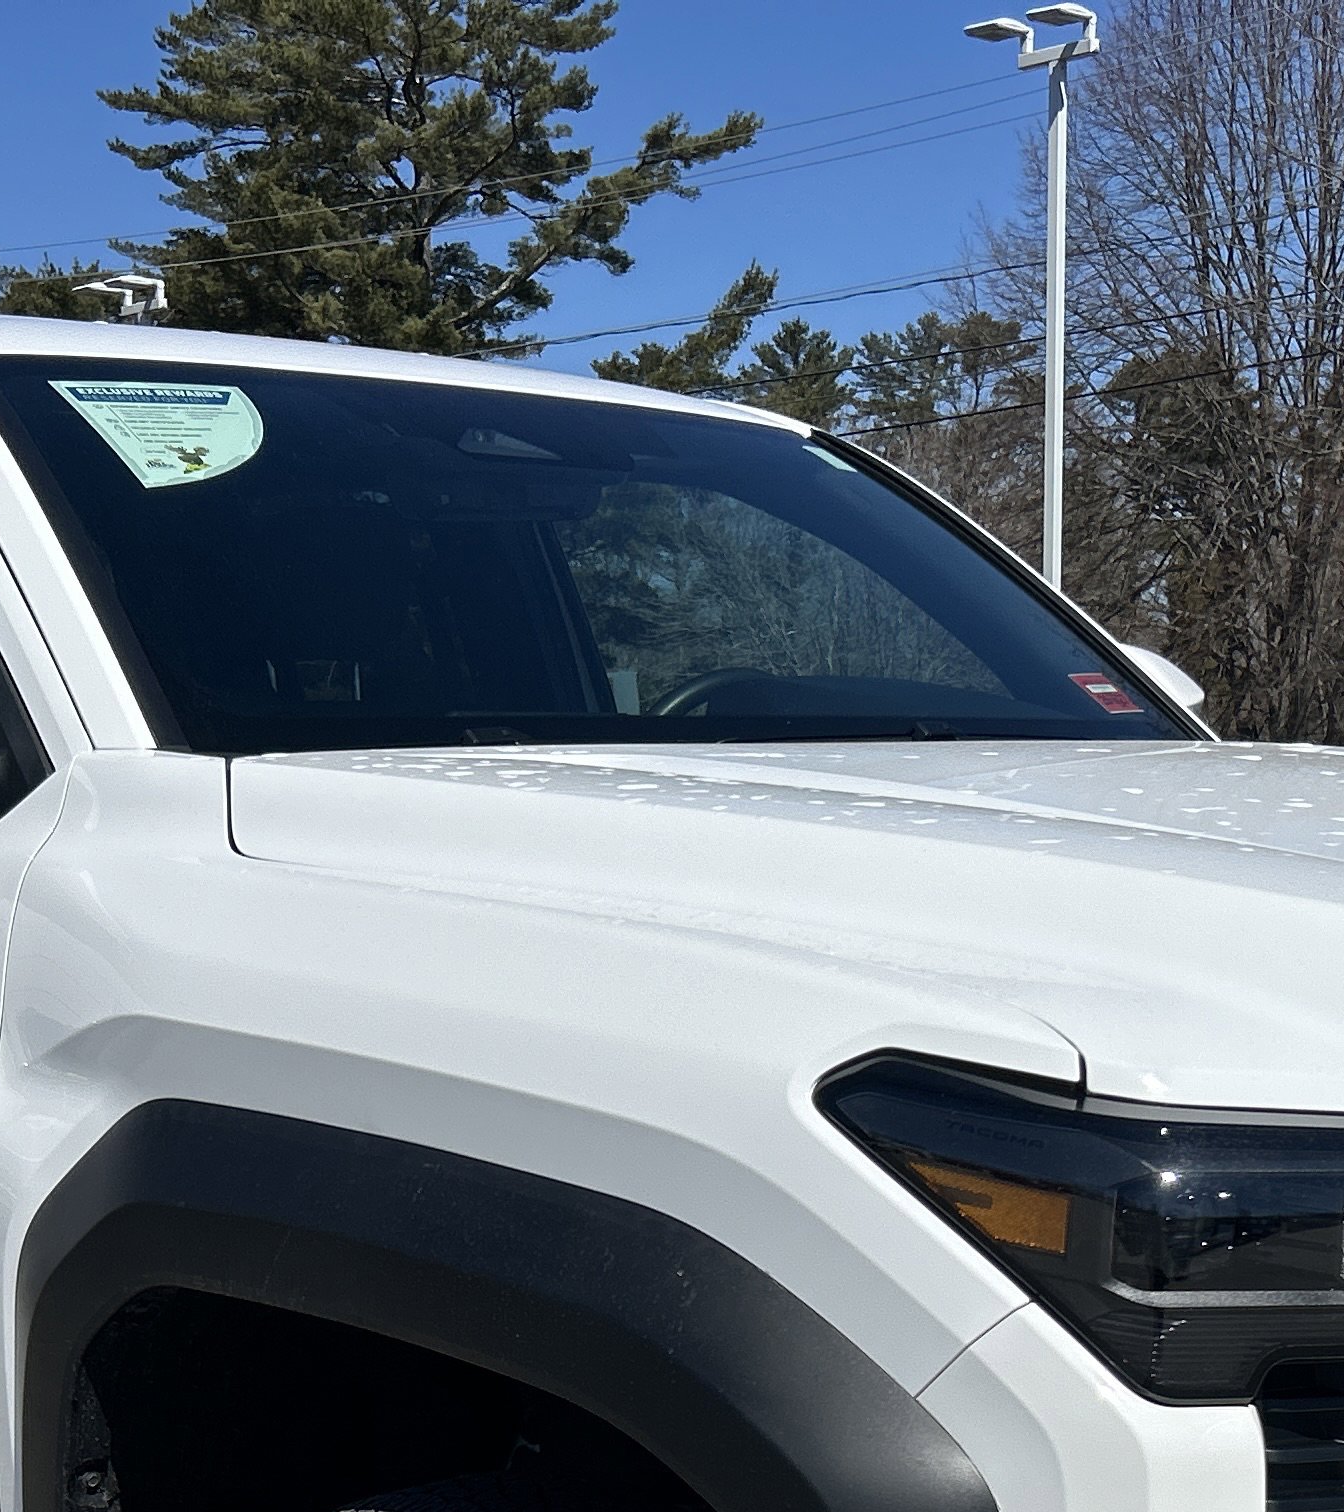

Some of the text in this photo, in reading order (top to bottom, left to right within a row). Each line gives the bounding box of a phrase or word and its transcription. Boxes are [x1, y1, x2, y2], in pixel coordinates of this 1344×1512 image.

[76, 387, 223, 399] EXCLUSIVE REWARDS
[947, 1120, 1045, 1149] TACOMA
